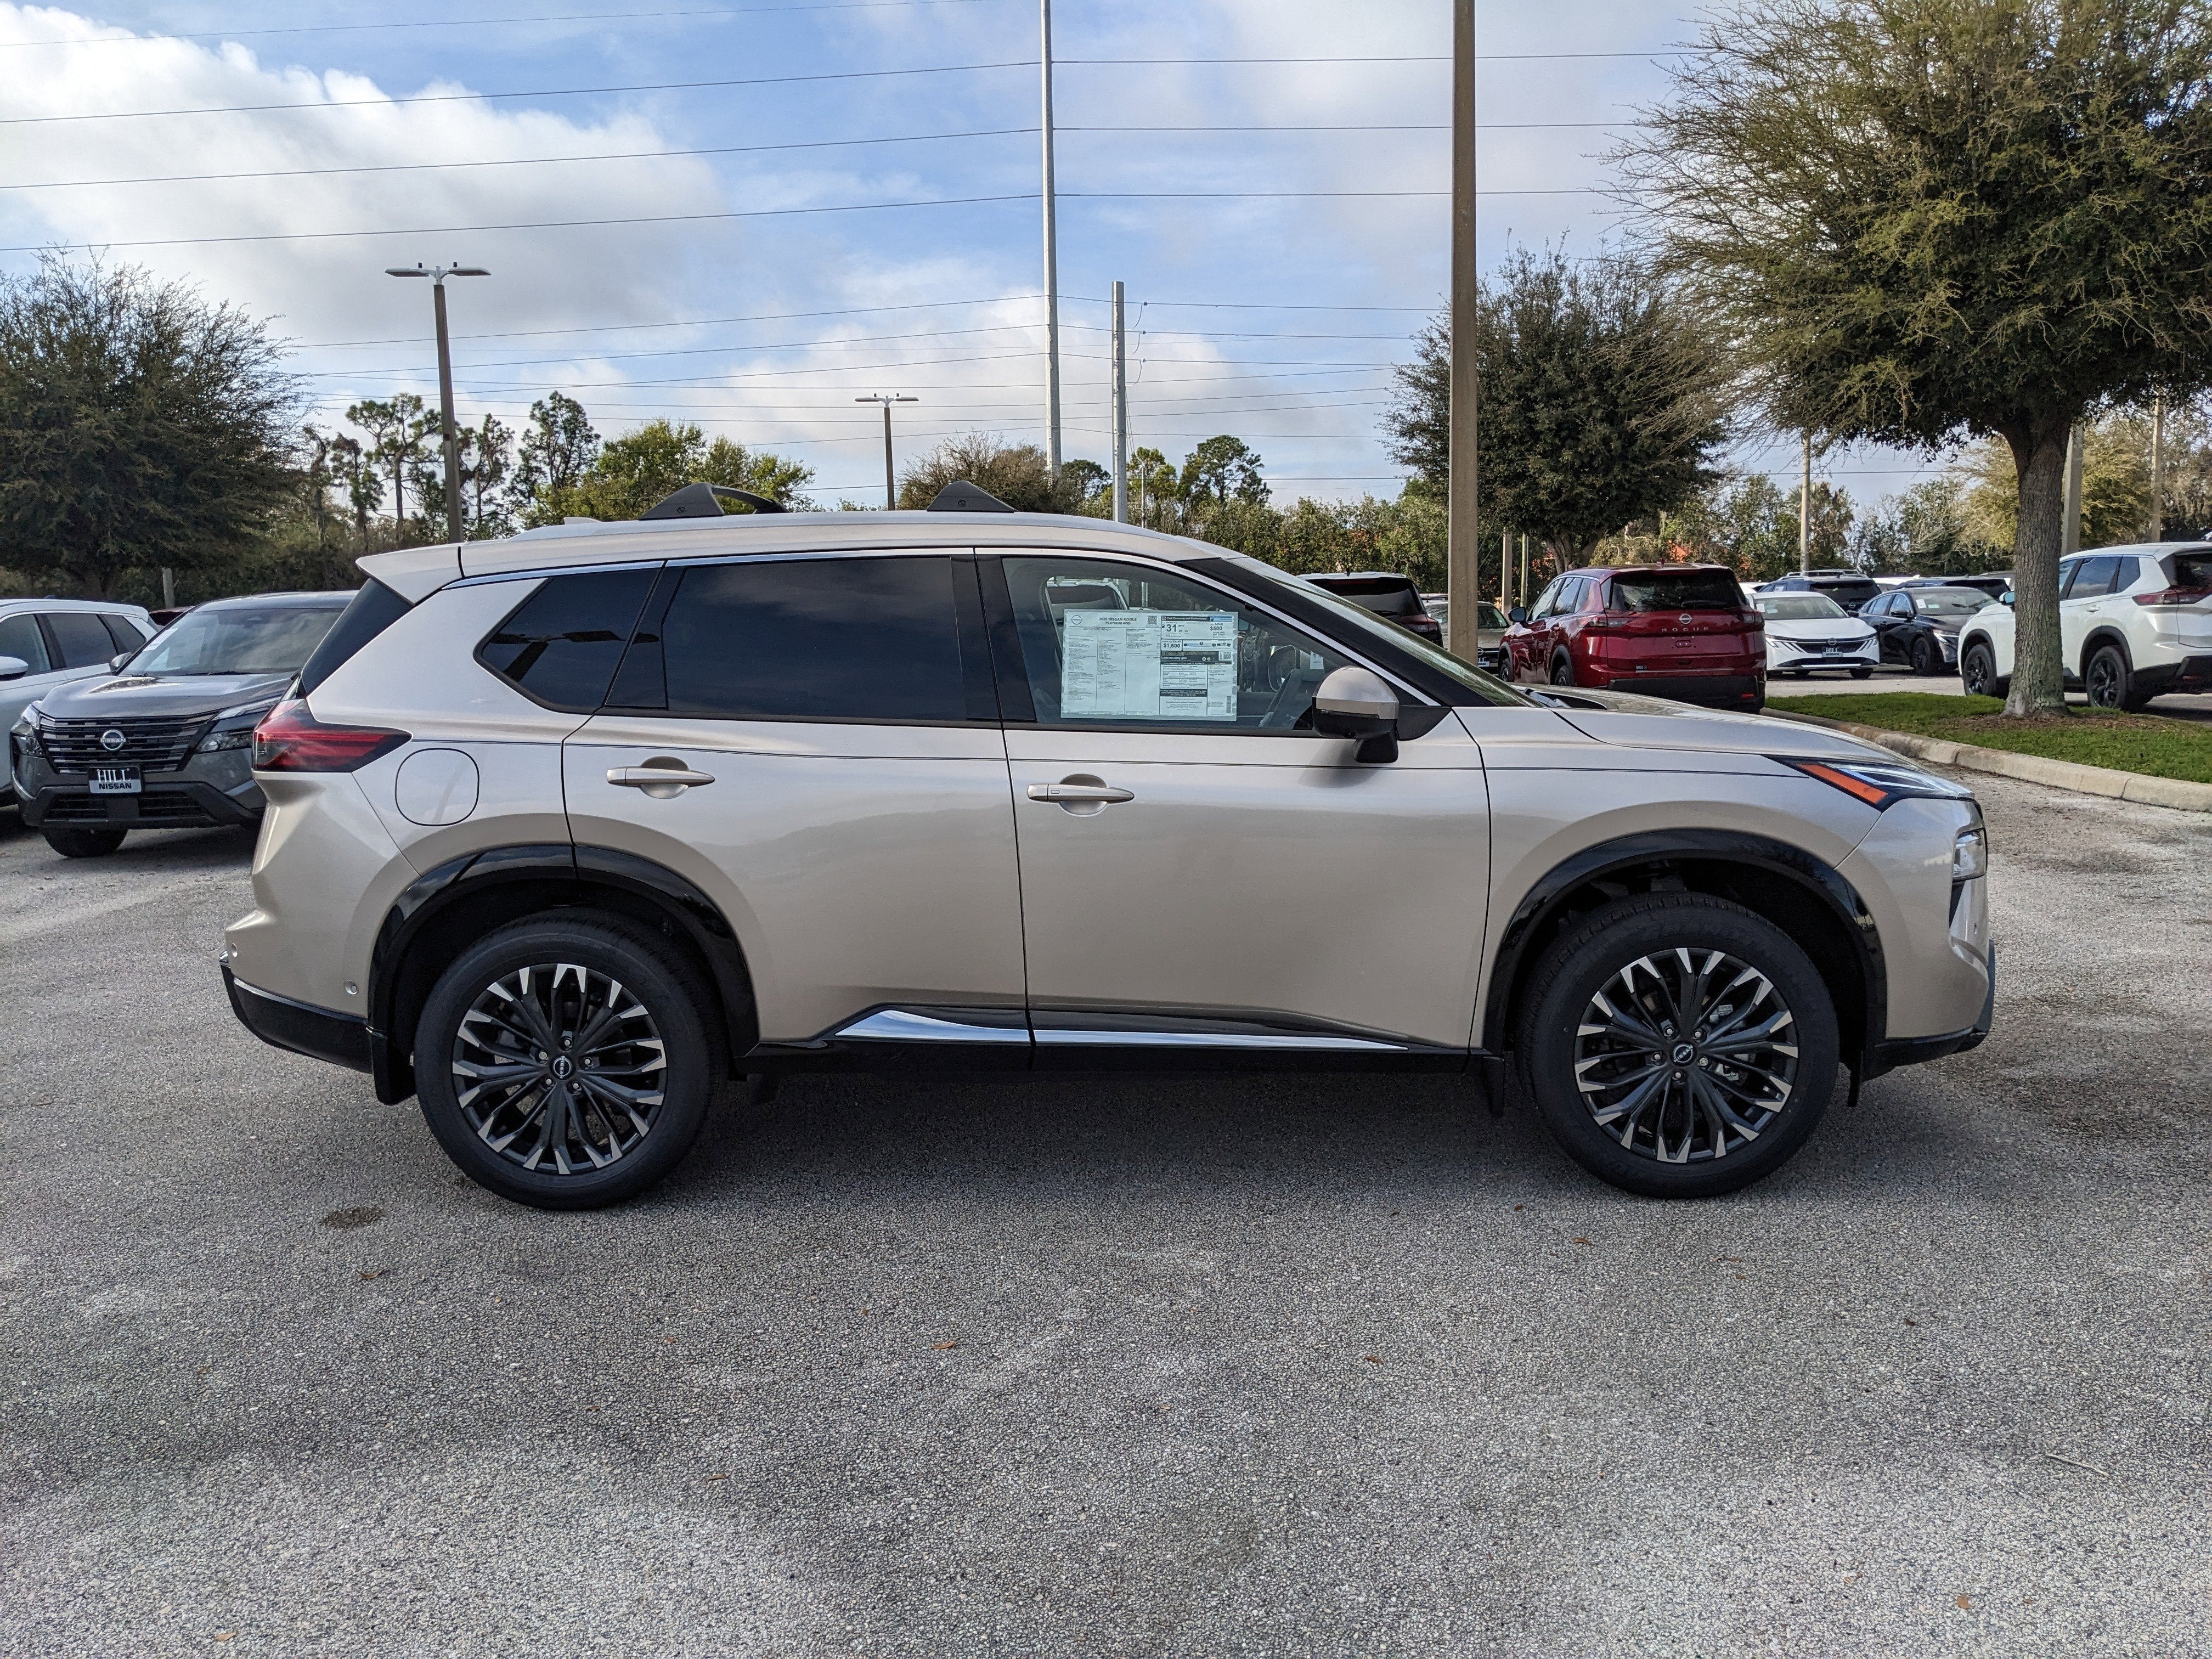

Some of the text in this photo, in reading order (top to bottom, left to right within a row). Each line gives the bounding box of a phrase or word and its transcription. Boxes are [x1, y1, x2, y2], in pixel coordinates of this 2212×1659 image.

[1166, 624, 1176, 632] 31
[97, 769, 131, 782] HILL
[1673, 1045, 1694, 1063] NISSAN
